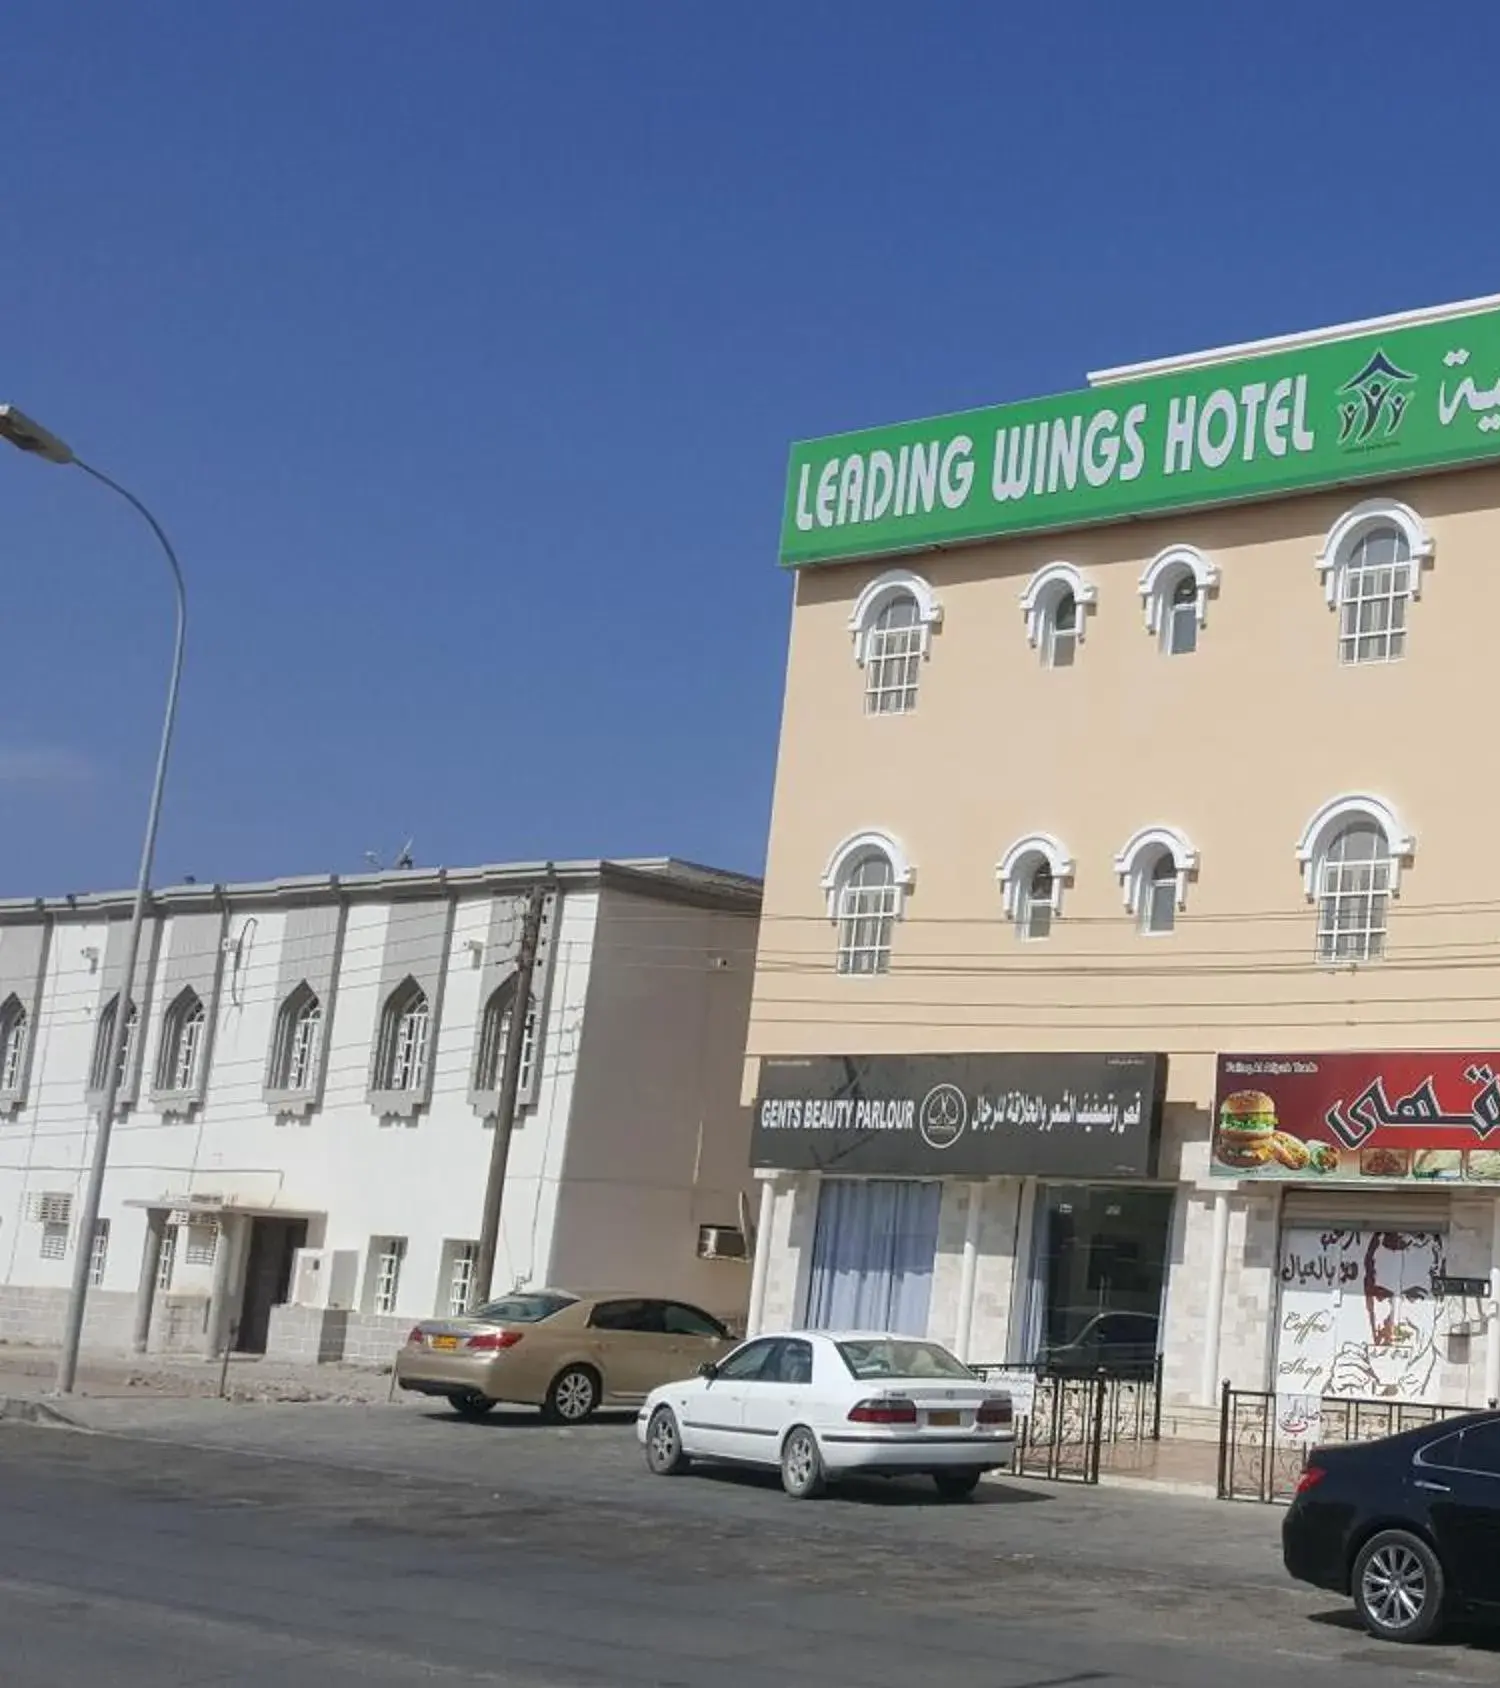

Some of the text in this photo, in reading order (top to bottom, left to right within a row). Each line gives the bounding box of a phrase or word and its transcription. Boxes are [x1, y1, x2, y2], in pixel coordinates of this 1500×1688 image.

[795, 374, 1315, 532] LEADING WINGS HOTEL
[761, 1100, 915, 1129] GENTS BEAUTY PARLOUR
[1046, 1089, 1076, 1132] الشعر
[1117, 1091, 1142, 1134] قص
[1283, 1309, 1335, 1345] Coffee
[1279, 1357, 1324, 1390] Shop
